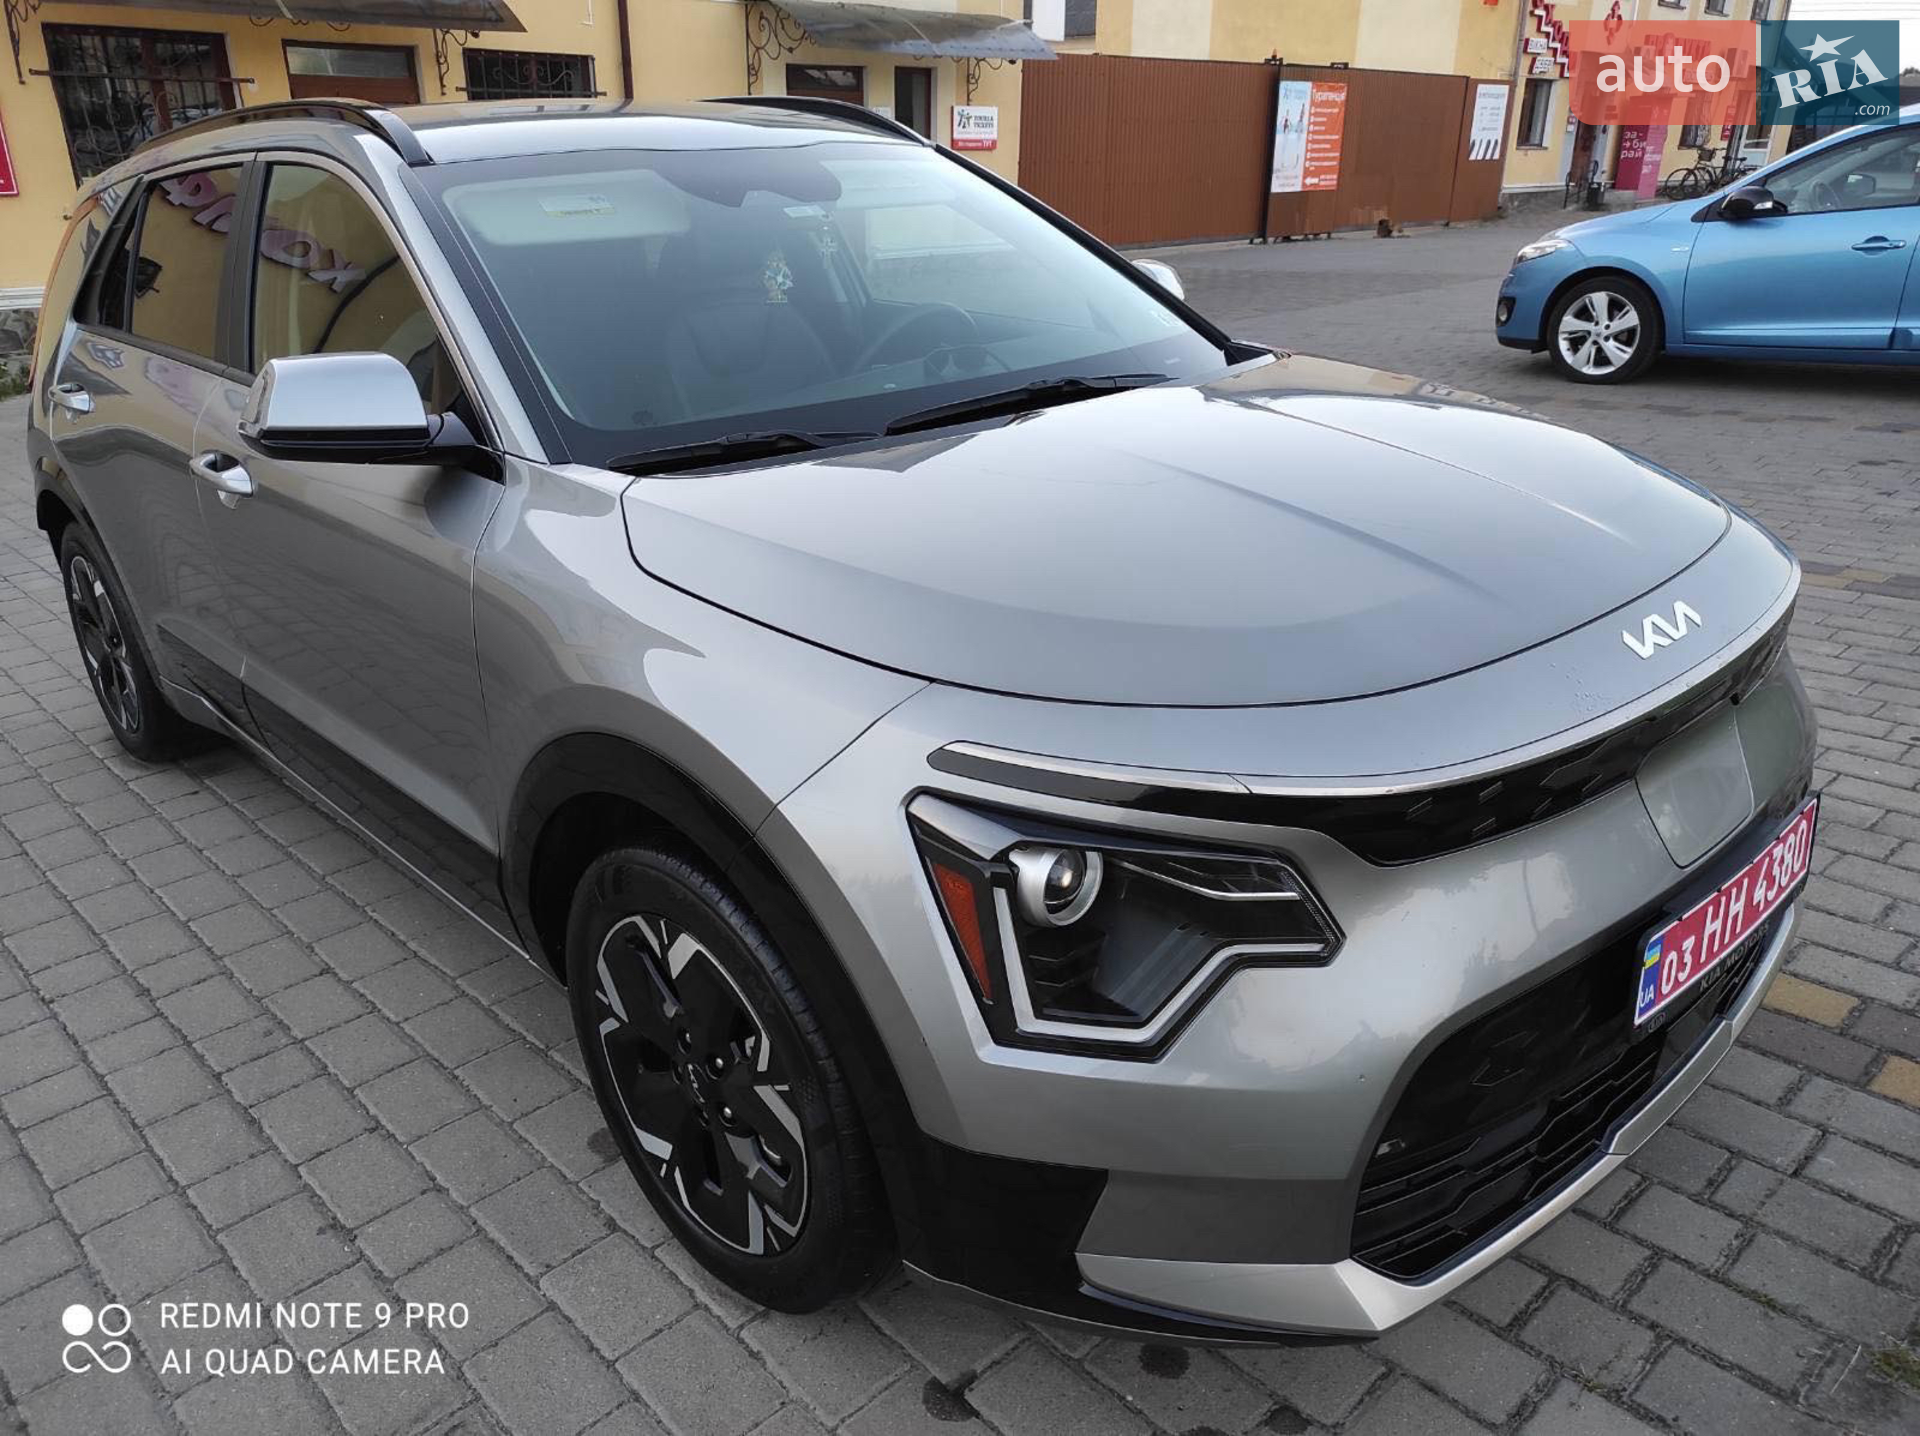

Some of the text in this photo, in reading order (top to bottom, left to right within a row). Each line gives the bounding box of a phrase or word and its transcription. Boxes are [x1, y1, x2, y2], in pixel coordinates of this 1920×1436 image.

[1661, 935, 1695, 995] 03
[1752, 820, 1808, 912] 4380
[1699, 922, 1770, 993] KIA MOTORS
[1638, 986, 1655, 1009] UA
